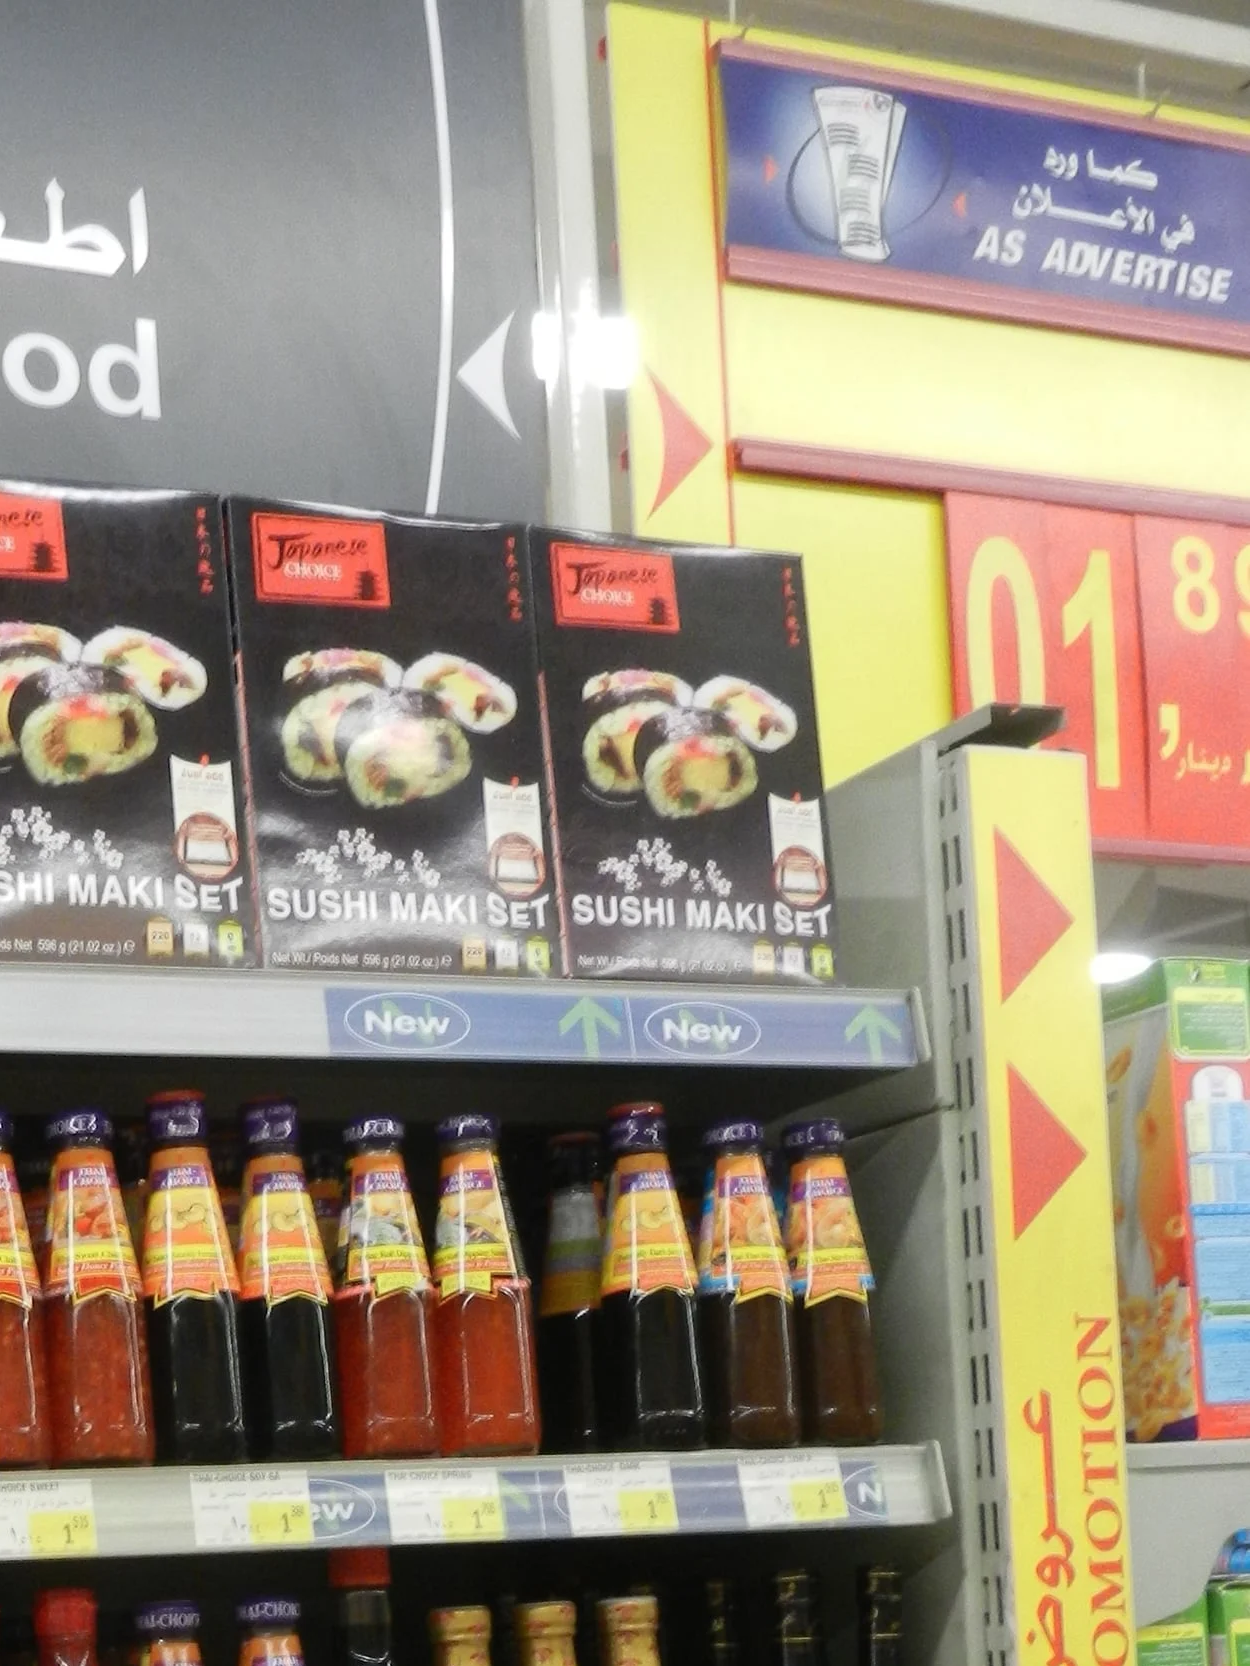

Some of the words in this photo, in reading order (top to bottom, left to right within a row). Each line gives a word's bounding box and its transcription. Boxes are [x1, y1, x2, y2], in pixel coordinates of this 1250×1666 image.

[972, 227, 1024, 266] AS
[1039, 238, 1234, 305] ADVERTISE
[68, 873, 165, 909] MAKI
[174, 875, 246, 914] SET
[268, 889, 378, 923] SUSHI
[389, 893, 478, 925] MAKI
[486, 896, 550, 929] SET
[572, 895, 675, 928] SUSHI
[685, 899, 768, 932] MAKI
[774, 902, 833, 938] SET
[363, 1006, 453, 1042] New
[661, 1013, 741, 1048] New
